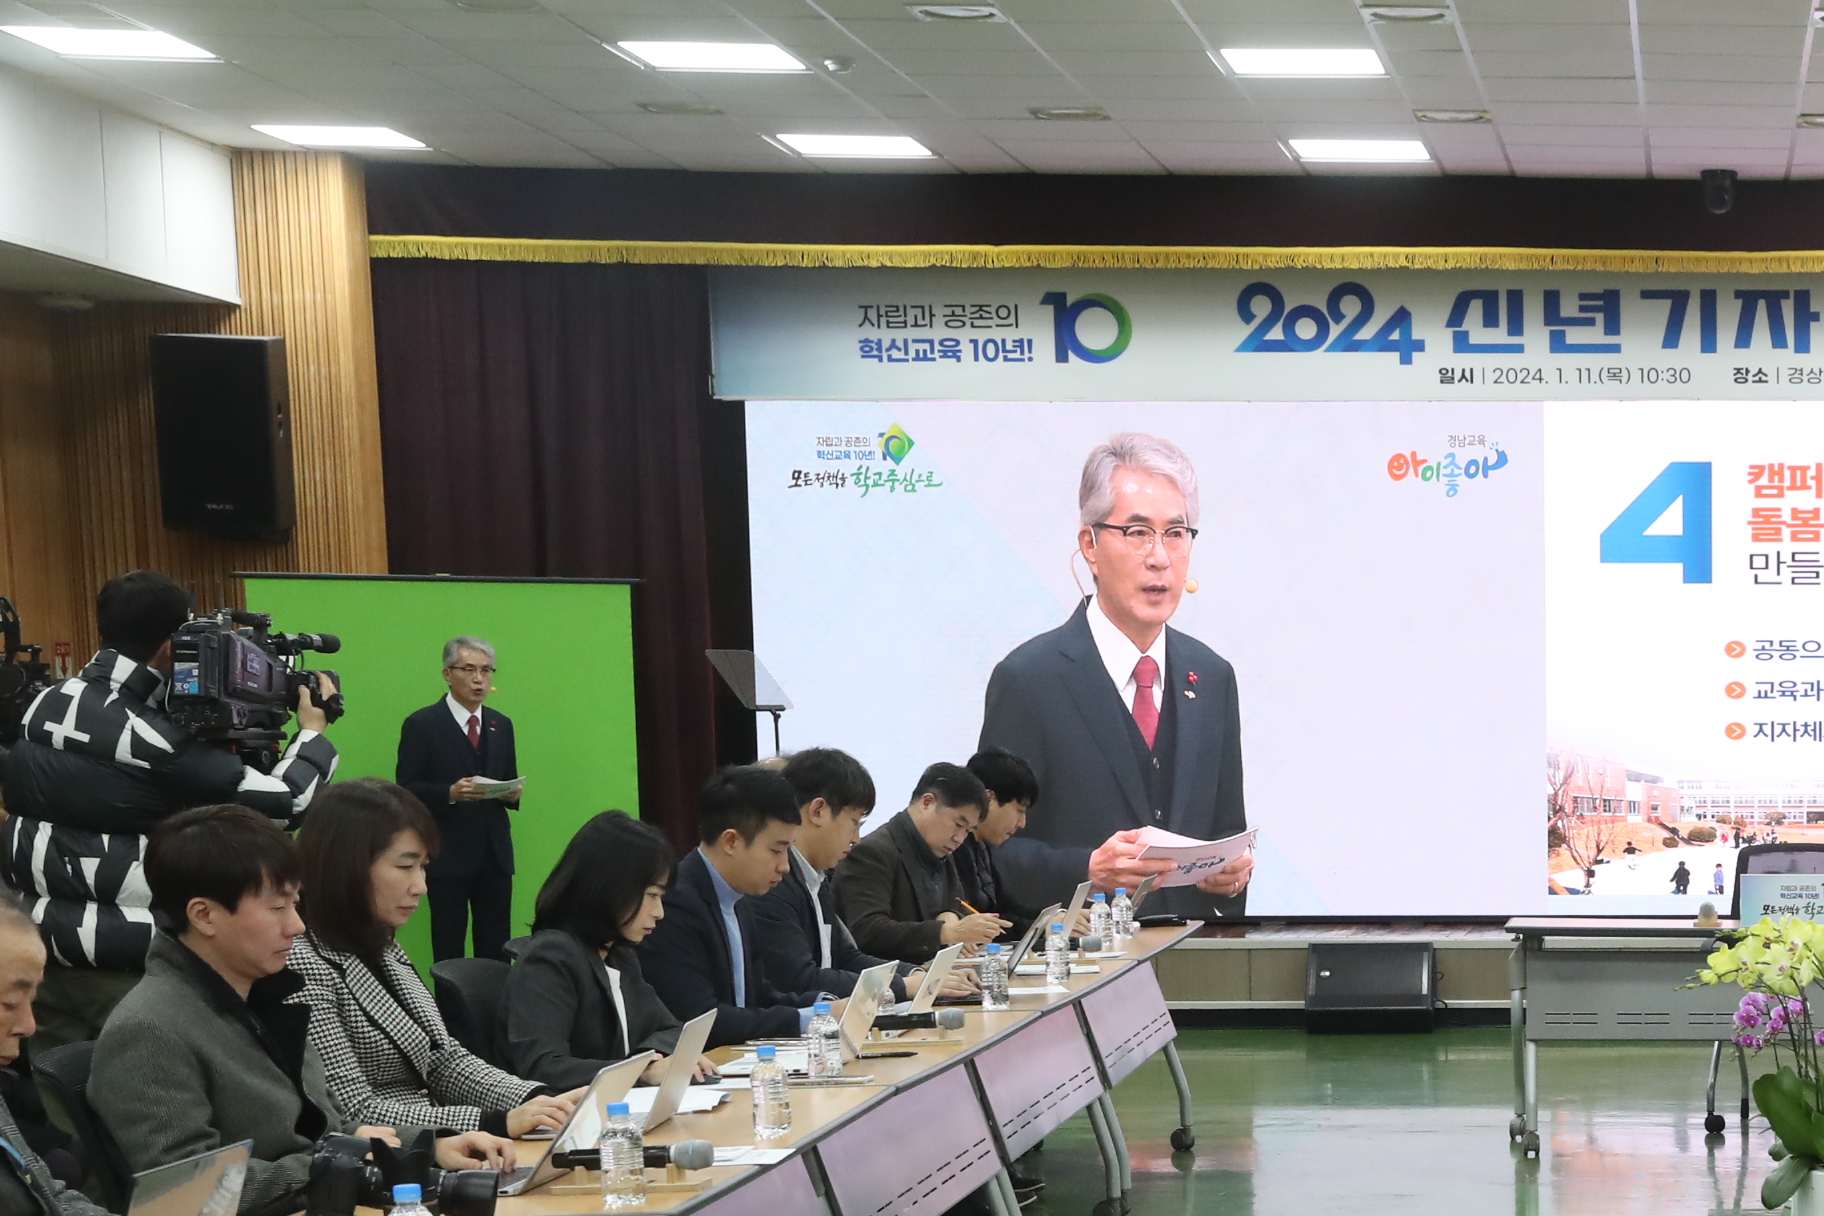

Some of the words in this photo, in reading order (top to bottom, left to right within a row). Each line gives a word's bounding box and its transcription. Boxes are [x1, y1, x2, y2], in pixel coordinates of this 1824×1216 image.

[857, 302, 936, 330] 자립과
[940, 302, 1020, 330] 공존의
[1040, 290, 1133, 364] 10
[1234, 281, 1425, 365] 2024
[858, 337, 962, 364] 혁신교육
[969, 337, 1034, 363] 10년!
[1438, 367, 1474, 385] 일시
[1492, 367, 1551, 385] 2024.
[1555, 367, 1570, 385] 1.
[1575, 367, 1632, 386] 11.(목)
[1637, 367, 1692, 385] 10:30
[1732, 367, 1769, 385] 장소
[816, 437, 842, 447] 자립과
[844, 437, 871, 448] 공존의
[1447, 434, 1487, 448] 경남교육
[816, 450, 851, 461] 혁신교육
[853, 450, 876, 461] 10년!
[850, 464, 943, 498] 학교중심으로
[1387, 448, 1508, 498] 아이좋아
[1600, 461, 1713, 584] 4
